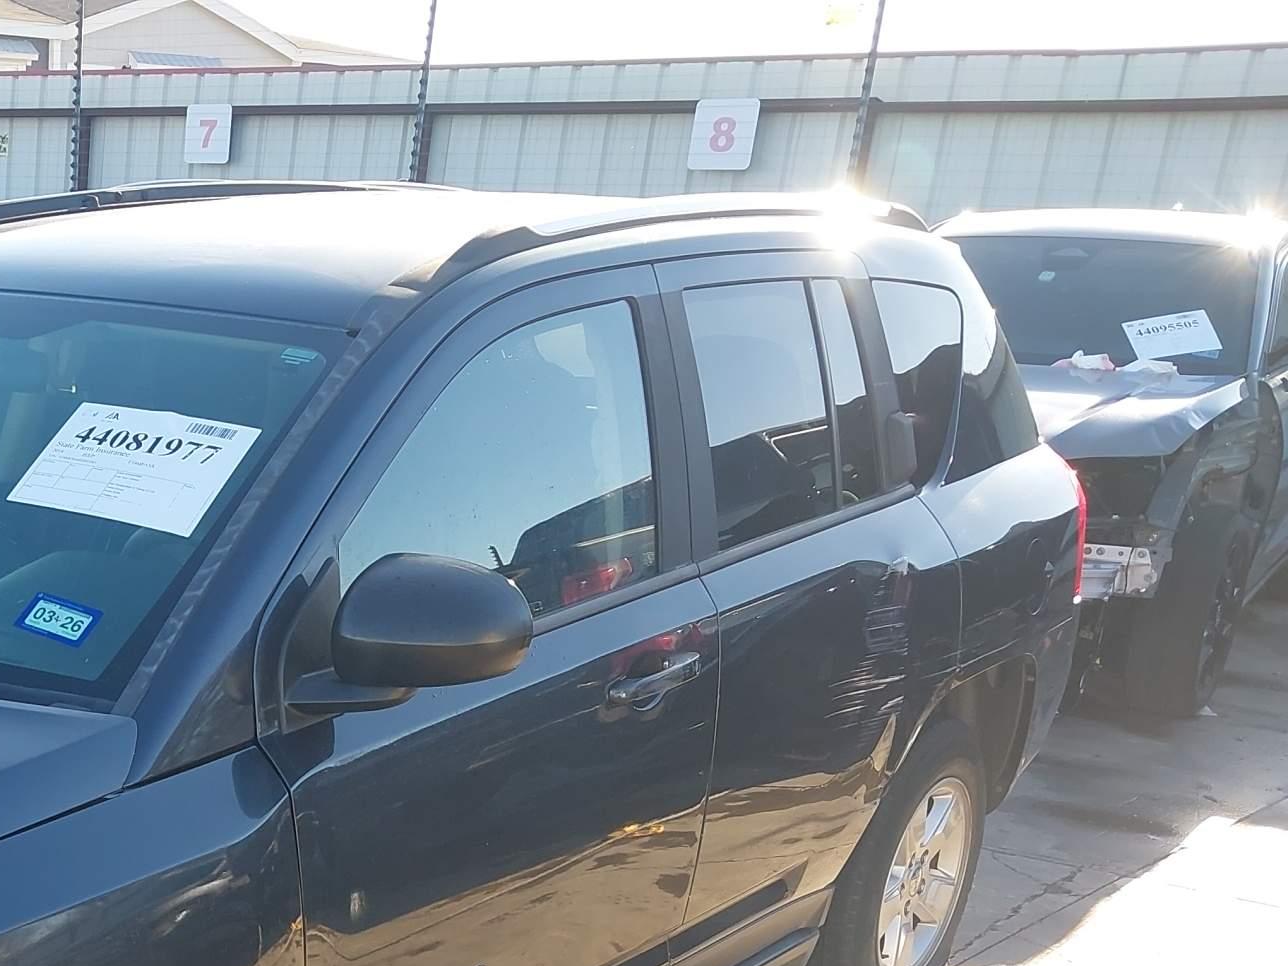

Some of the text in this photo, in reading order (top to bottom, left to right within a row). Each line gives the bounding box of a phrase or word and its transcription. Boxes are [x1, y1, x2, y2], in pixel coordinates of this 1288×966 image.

[199, 119, 218, 149] 7
[709, 116, 737, 153] 8
[1136, 319, 1200, 337] 44095505
[74, 425, 224, 464] 44081977
[75, 443, 94, 452] Farm
[95, 446, 132, 458] Insurance
